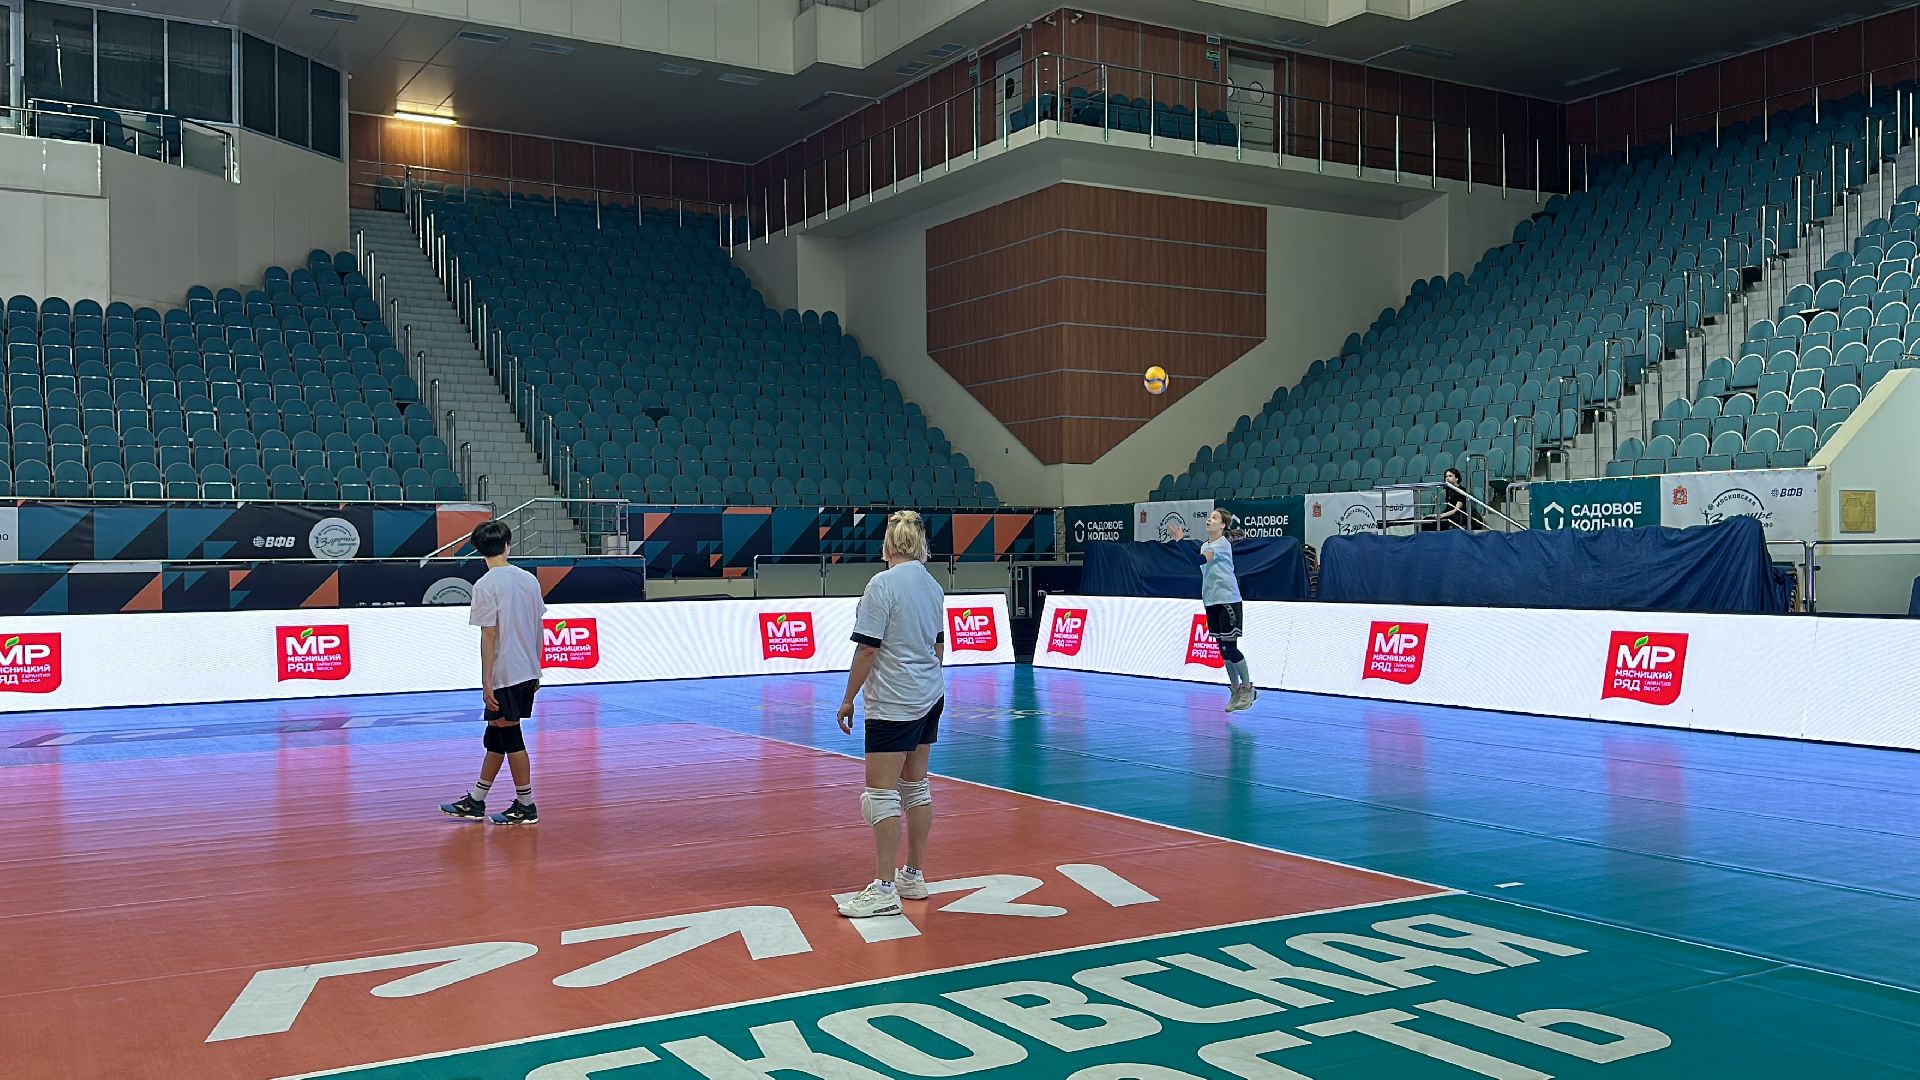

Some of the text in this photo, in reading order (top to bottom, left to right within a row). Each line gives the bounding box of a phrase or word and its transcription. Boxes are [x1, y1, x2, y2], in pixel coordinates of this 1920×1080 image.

[1780, 488, 1803, 497] ВФВ
[1716, 493, 1756, 507] МОСКОВСКАЯ
[1571, 501, 1642, 518] САДОВОЕ
[1087, 520, 1124, 531] САДОВОЕ
[1244, 515, 1289, 527] САДОВОЕ
[1244, 528, 1283, 538] КОЛЬЦО
[1342, 522, 1378, 535] Заречь
[265, 536, 295, 548] ВФВ
[1087, 531, 1119, 541] КОЛЬЦО
[766, 620, 807, 637] МР
[954, 615, 989, 631] МР
[1055, 617, 1082, 633] МР
[543, 627, 590, 646] МР
[1194, 624, 1216, 643] М
[285, 635, 341, 656] МР
[957, 637, 974, 645] РЯД
[1374, 632, 1419, 655] МР
[544, 644, 591, 653] МЯСНИЦКИЙ
[769, 644, 789, 652] РЯД
[287, 653, 341, 663] МЯСНИЦКИЙ
[545, 653, 568, 662] РЯД
[1372, 654, 1416, 662] МЯСНИЦКИЙ
[1616, 644, 1676, 670] МР
[287, 663, 314, 673] РЯД
[1370, 661, 1392, 673] РЯД
[1615, 669, 1673, 680] МЯСНИЦКИЙ
[1613, 678, 1641, 692] РЯД
[1066, 1000, 1672, 1080] СТЬ
